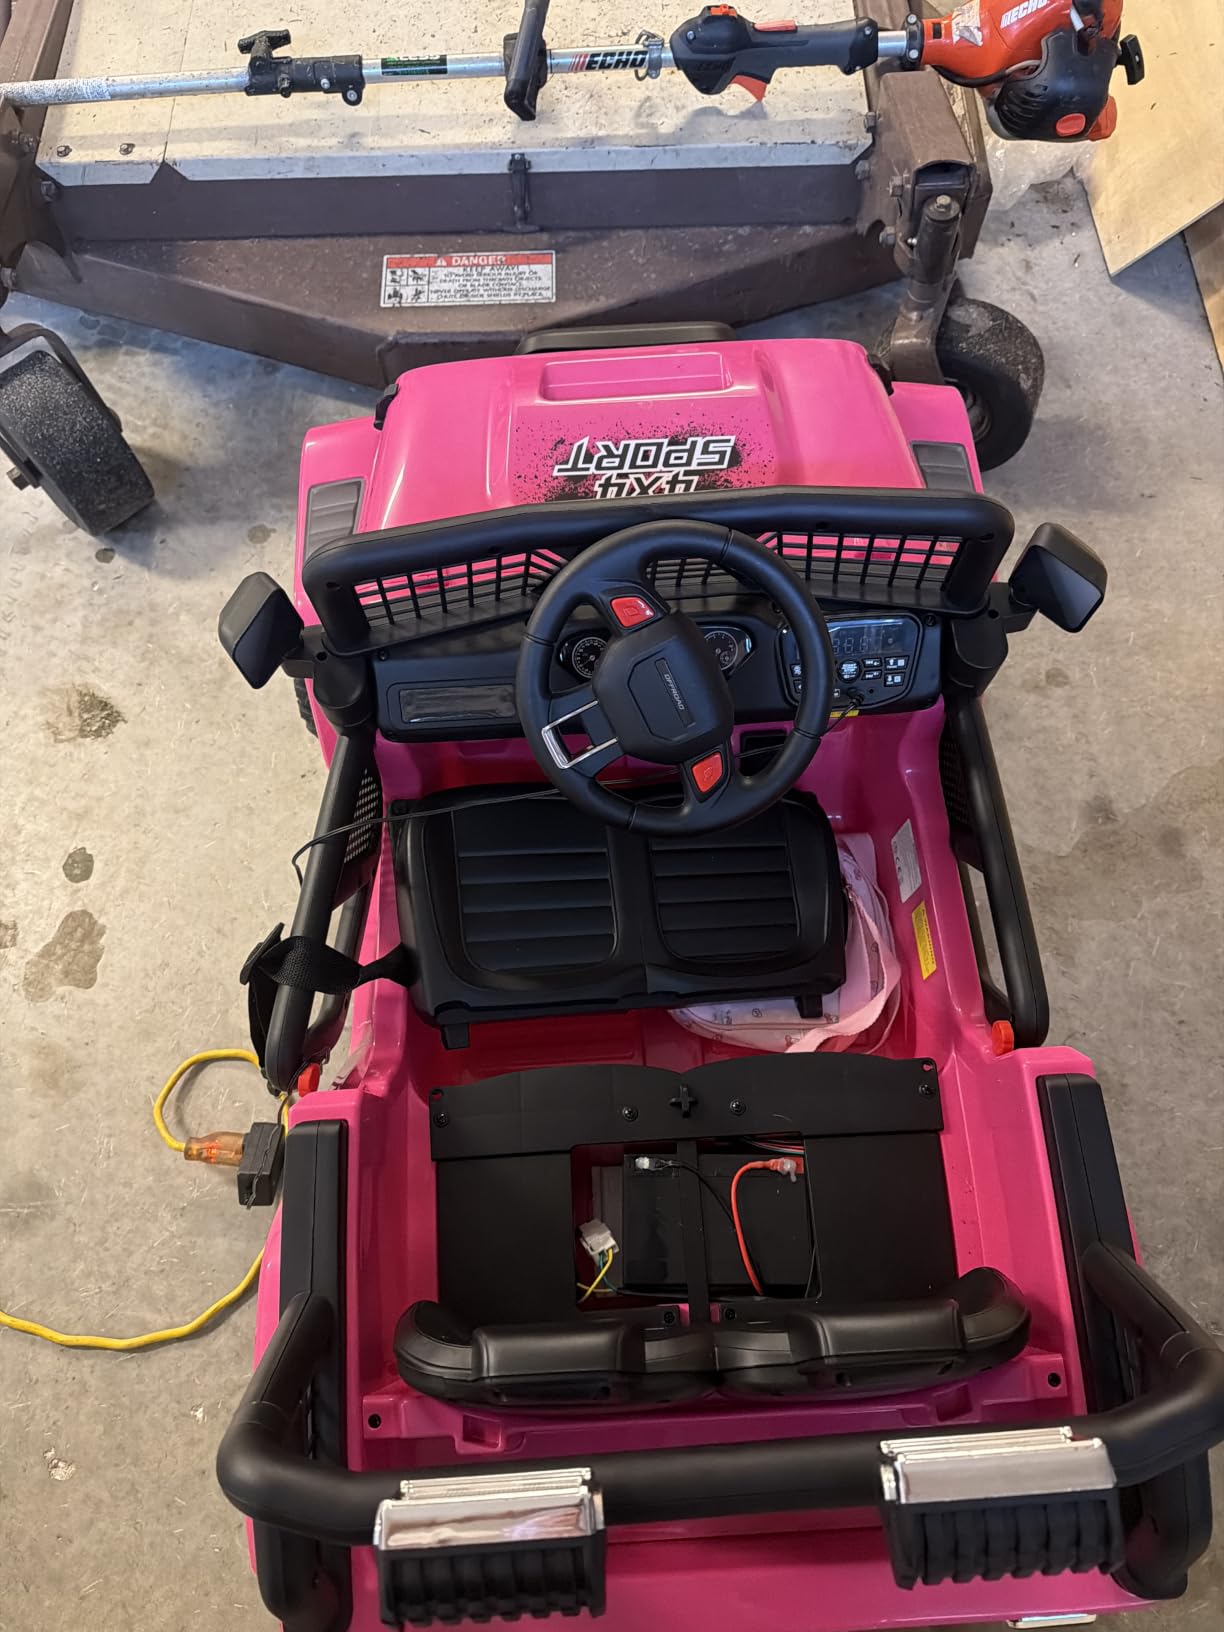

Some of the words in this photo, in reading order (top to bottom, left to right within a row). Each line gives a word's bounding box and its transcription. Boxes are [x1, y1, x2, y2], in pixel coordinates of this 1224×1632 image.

[1010, 0, 1047, 23] ECHO
[585, 50, 648, 71] ECHO
[452, 256, 506, 266] DANGER
[552, 435, 736, 476] SPORT
[594, 470, 699, 499] 4X4
[664, 673, 685, 711] OFFROAD
